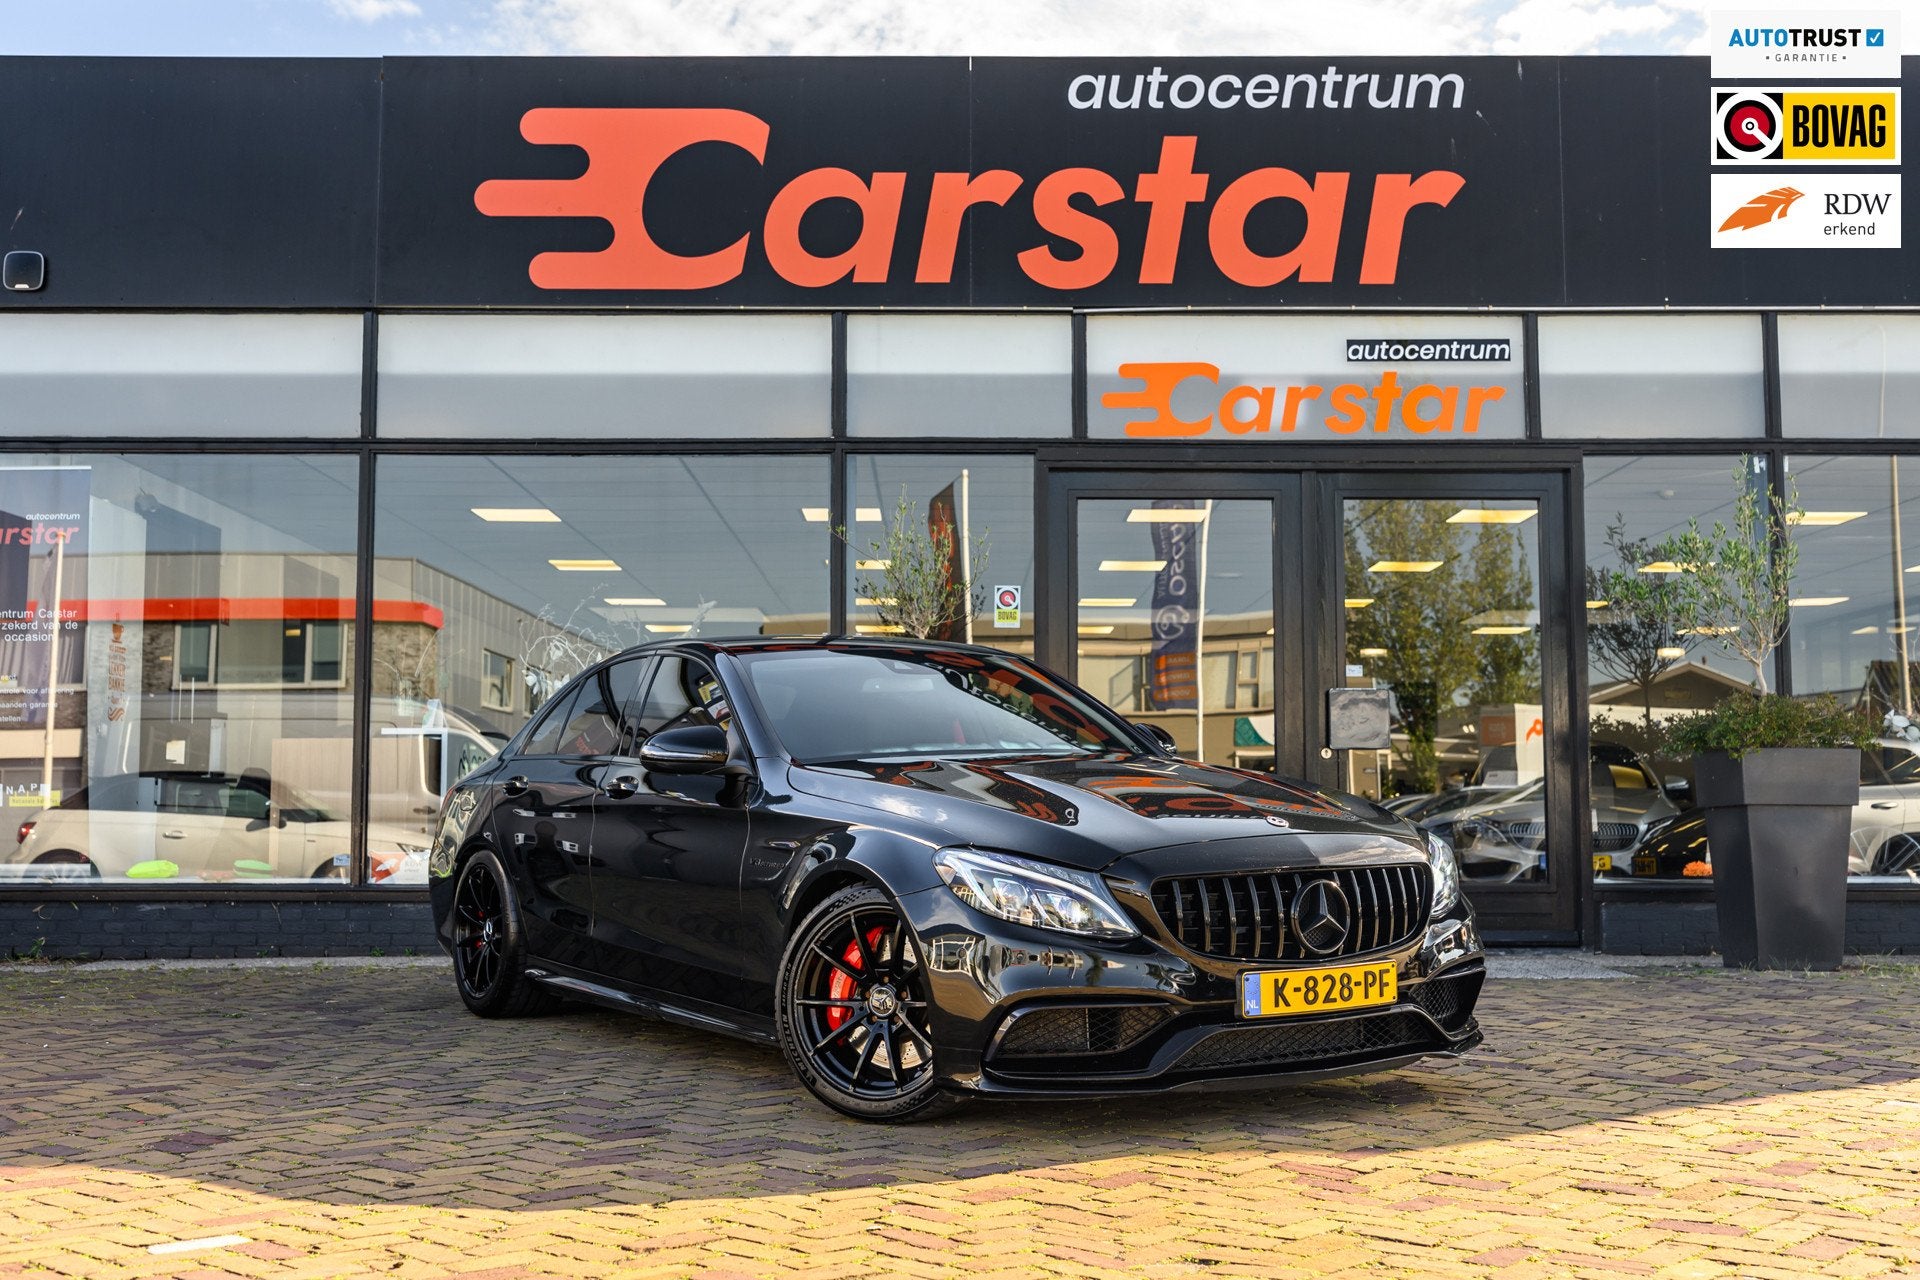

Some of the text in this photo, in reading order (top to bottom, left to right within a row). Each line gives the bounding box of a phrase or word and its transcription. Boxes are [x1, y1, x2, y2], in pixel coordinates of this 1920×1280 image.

[1066, 65, 1466, 111] autocentrum
[474, 107, 1466, 290] Carstar
[1347, 340, 1510, 361] autocentrum
[1101, 362, 1507, 438] Carstar
[65, 621, 78, 630] de
[997, 611, 1018, 621] BOVAG
[1246, 1000, 1259, 1009] NL
[1273, 968, 1391, 1008] K-828-PF
[782, 1014, 807, 1071] MICHELIN
